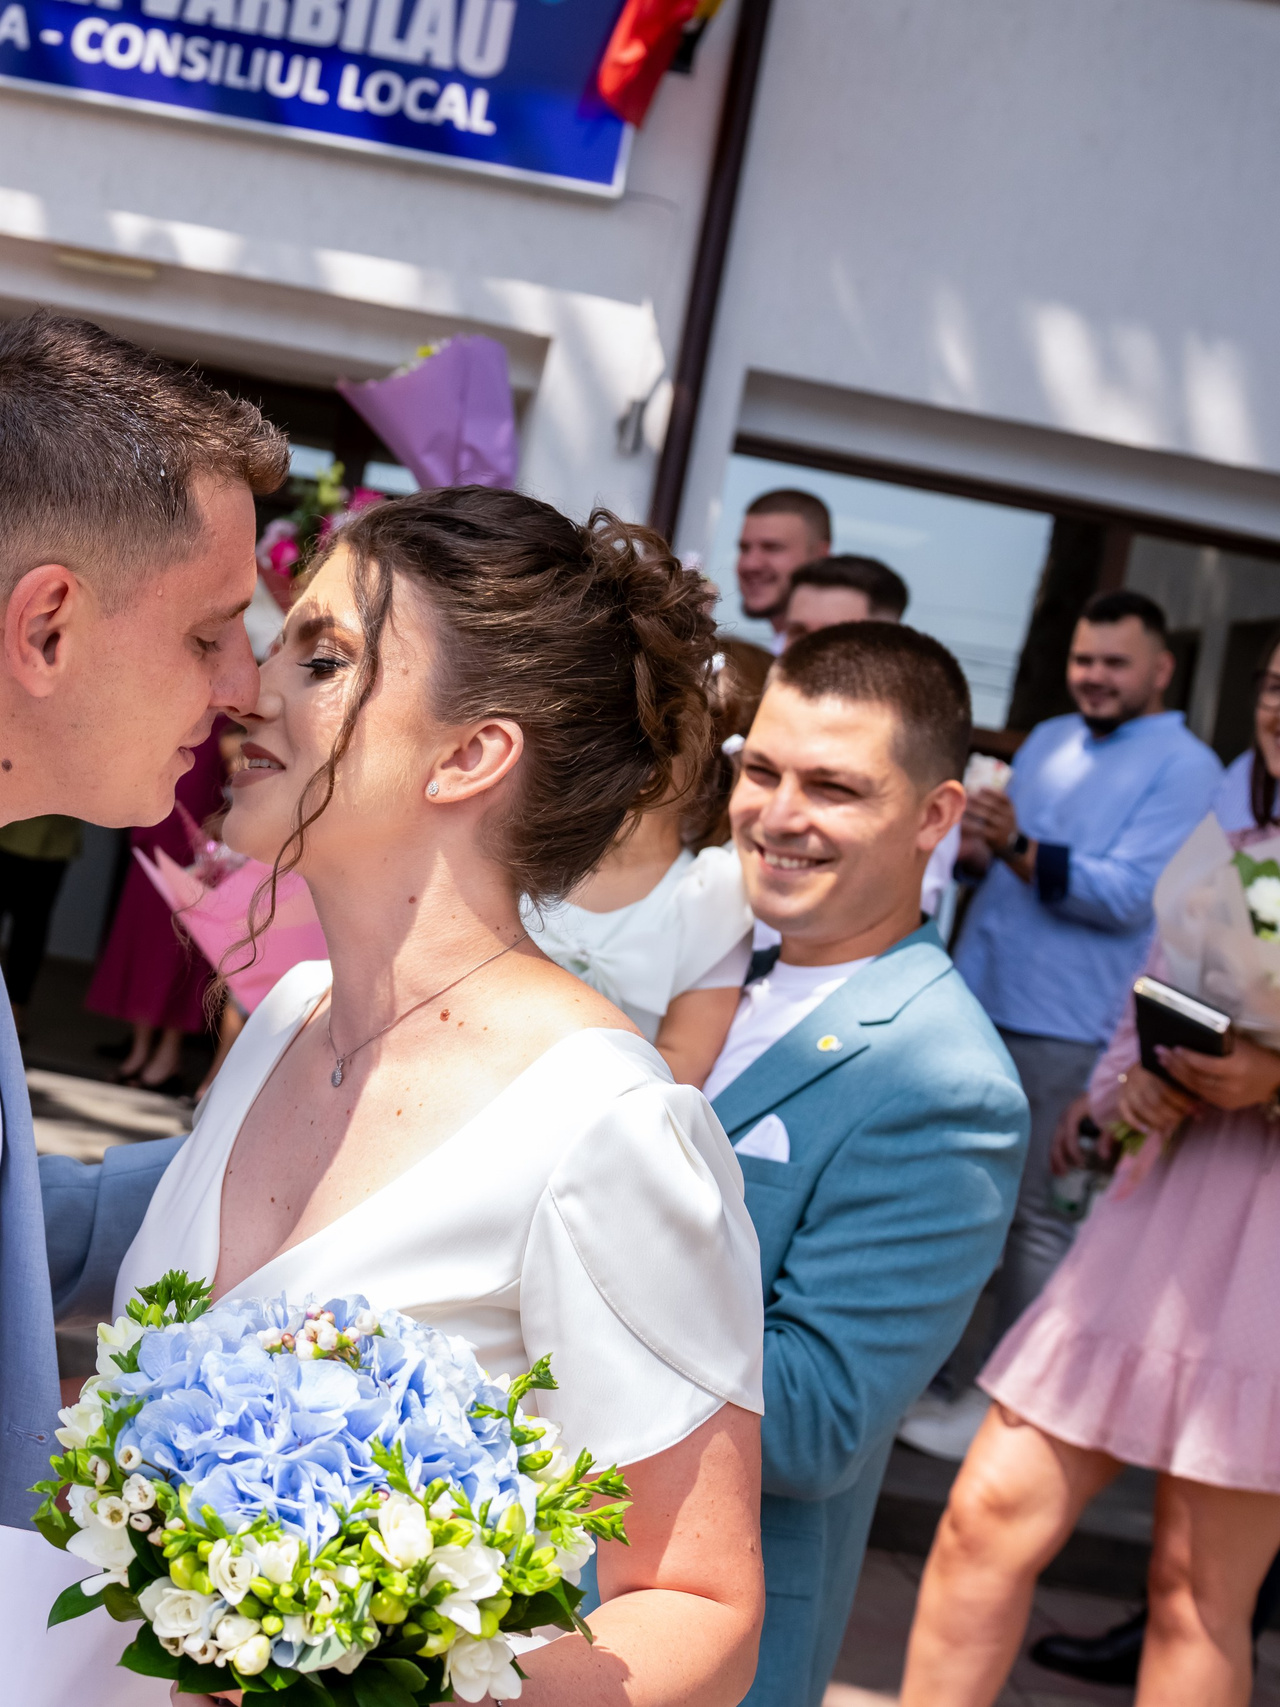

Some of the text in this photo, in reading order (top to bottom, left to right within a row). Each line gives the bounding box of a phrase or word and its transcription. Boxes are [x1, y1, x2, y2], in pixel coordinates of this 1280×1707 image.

[39, 28, 64, 46] -
[71, 17, 329, 105] CONSILIUL
[337, 63, 496, 136] LOCAL
[141, 0, 518, 78] BILAU
